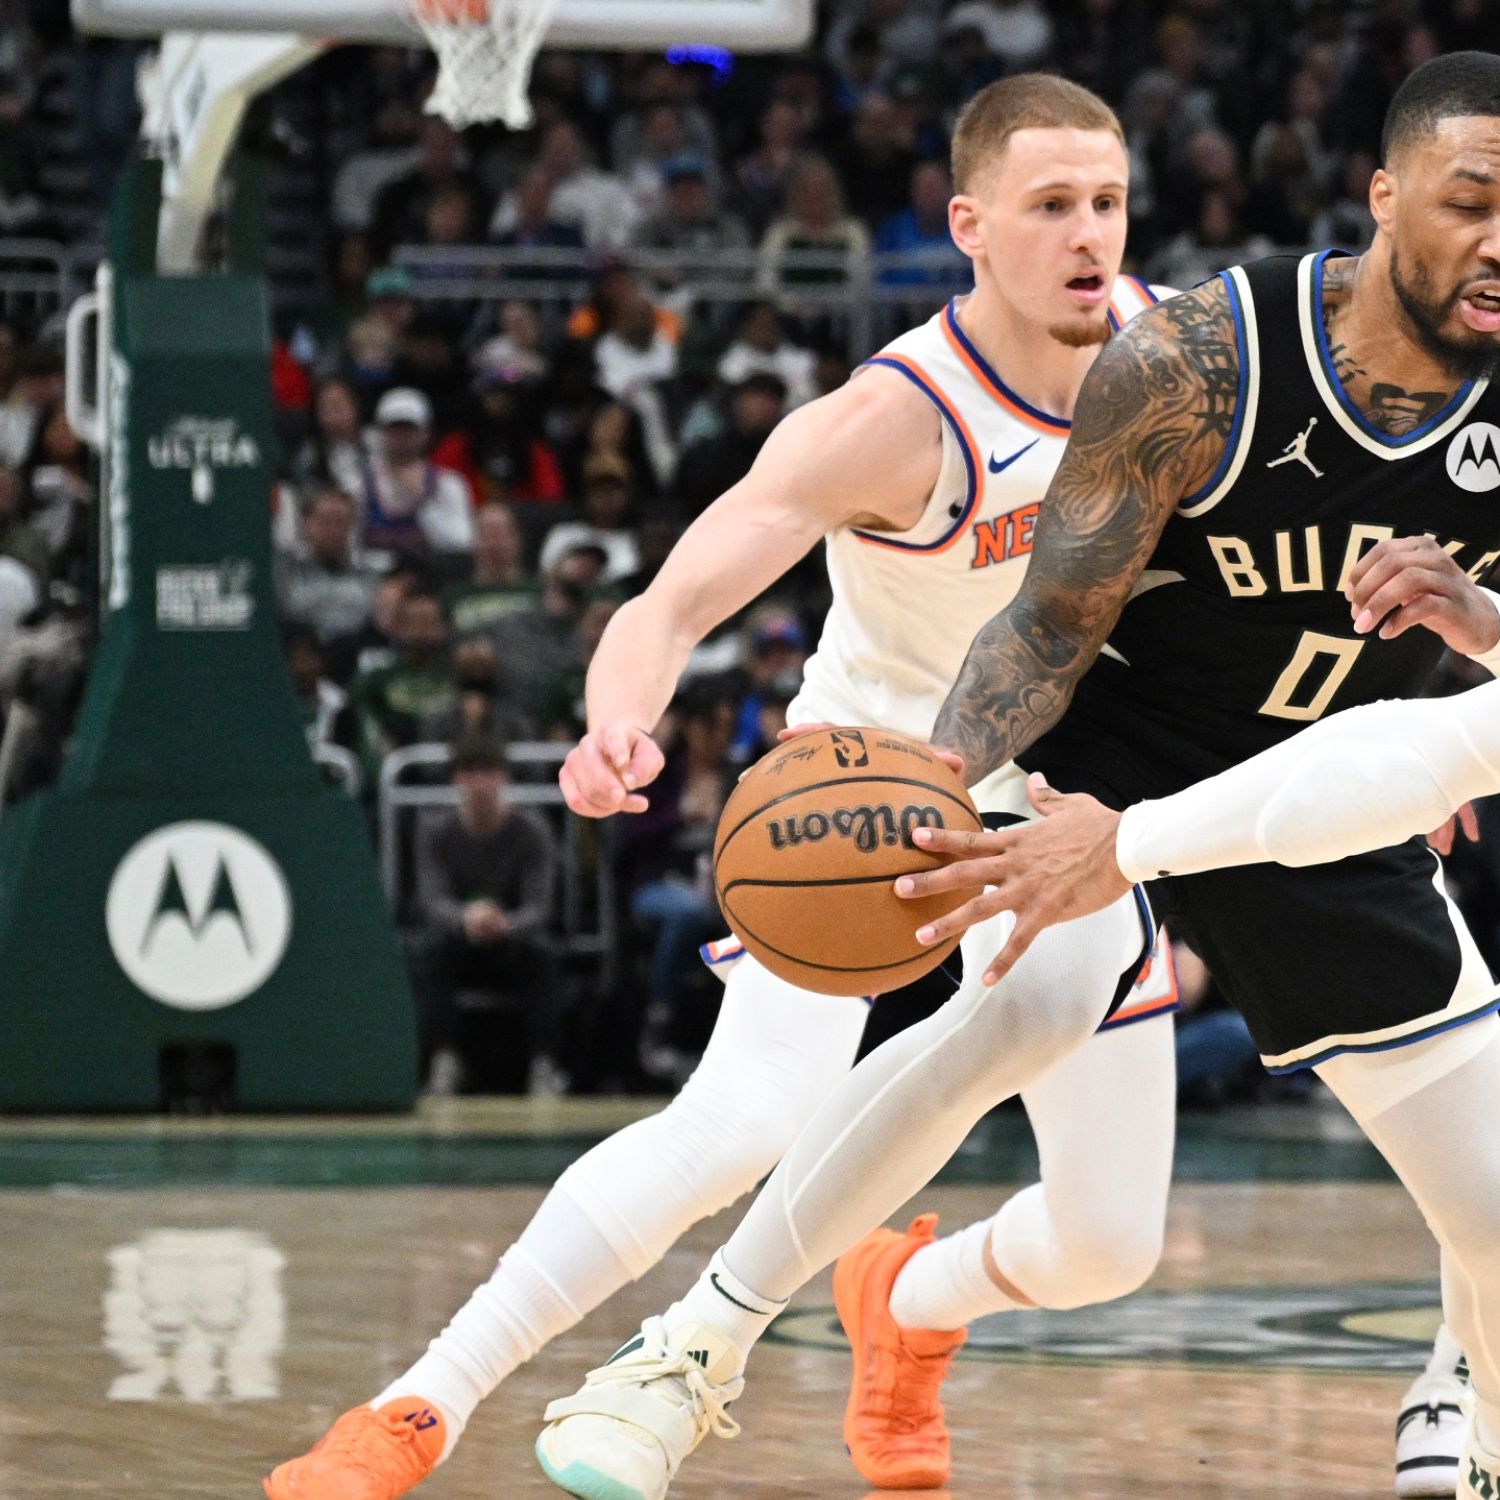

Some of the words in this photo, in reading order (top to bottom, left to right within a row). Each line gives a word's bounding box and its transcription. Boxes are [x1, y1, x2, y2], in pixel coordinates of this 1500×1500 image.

[971, 501, 1041, 570] NE
[1257, 630, 1367, 722] 0
[767, 803, 945, 853] Wilson
